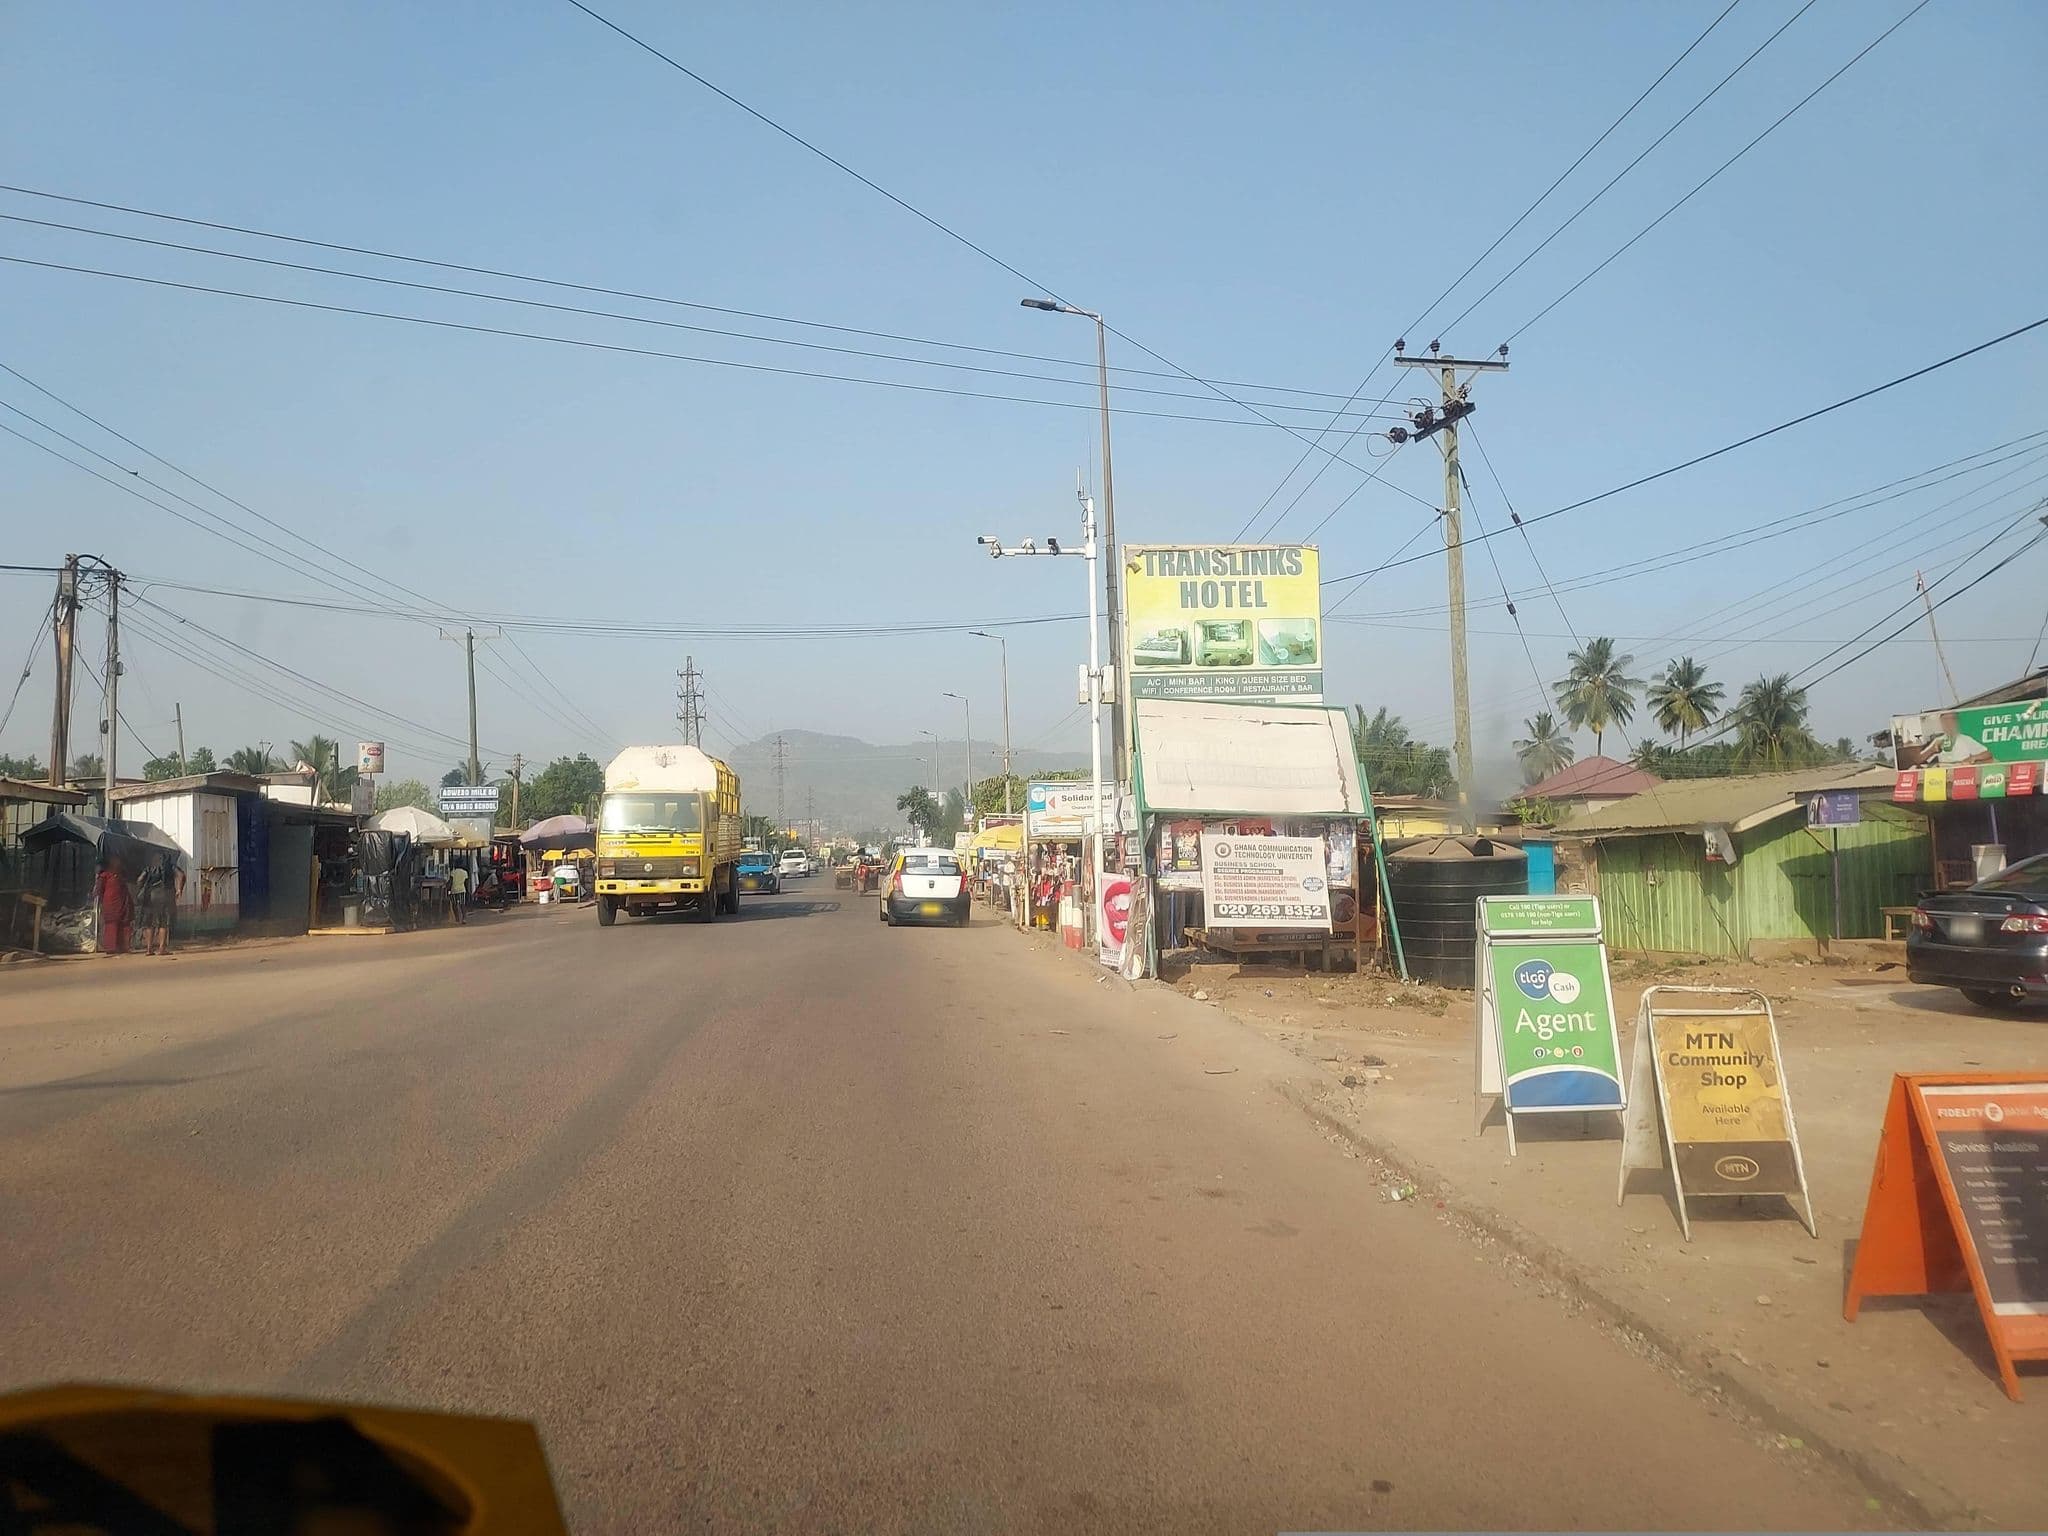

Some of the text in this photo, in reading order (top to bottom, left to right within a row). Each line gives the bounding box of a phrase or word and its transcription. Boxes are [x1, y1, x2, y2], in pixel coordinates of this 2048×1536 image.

[1144, 548, 1303, 577] TRANSLINKS
[1180, 580, 1268, 609] HOTEL
[1147, 678, 1161, 686] A/C
[1169, 678, 1186, 686] MINI
[1188, 677, 1206, 685] BAR
[1215, 677, 1235, 685] KING
[1241, 676, 1269, 684] QUEEN
[1271, 676, 1288, 684] SIZE
[1290, 675, 1307, 683] BED
[1164, 686, 1213, 695] CONFERENCE
[1215, 686, 1236, 694] ROOM
[1243, 685, 1289, 693] RESTAURANT
[1298, 684, 1313, 692] BAR
[1983, 710, 2048, 726] GIVE YUR
[1061, 793, 1113, 802] Solidarad
[1258, 844, 1313, 853] COMMUNICATION
[1276, 852, 1313, 860] UNIVERSITY
[1218, 904, 1322, 916] 020 269 8352
[1540, 919, 1553, 927] help
[1520, 970, 1546, 989] tigo
[1553, 982, 1575, 992] Cash
[1515, 1008, 1596, 1040] Agent
[1686, 1032, 1734, 1049] MTN
[1668, 1052, 1764, 1068] Community
[1701, 1072, 1747, 1089] Shop
[1702, 1104, 1750, 1114] Available
[1937, 1107, 1983, 1118] FIDELITY
[1715, 1116, 1741, 1125] Here
[1947, 1142, 2040, 1153] Services Available
[1725, 1162, 1749, 1173] MTN
